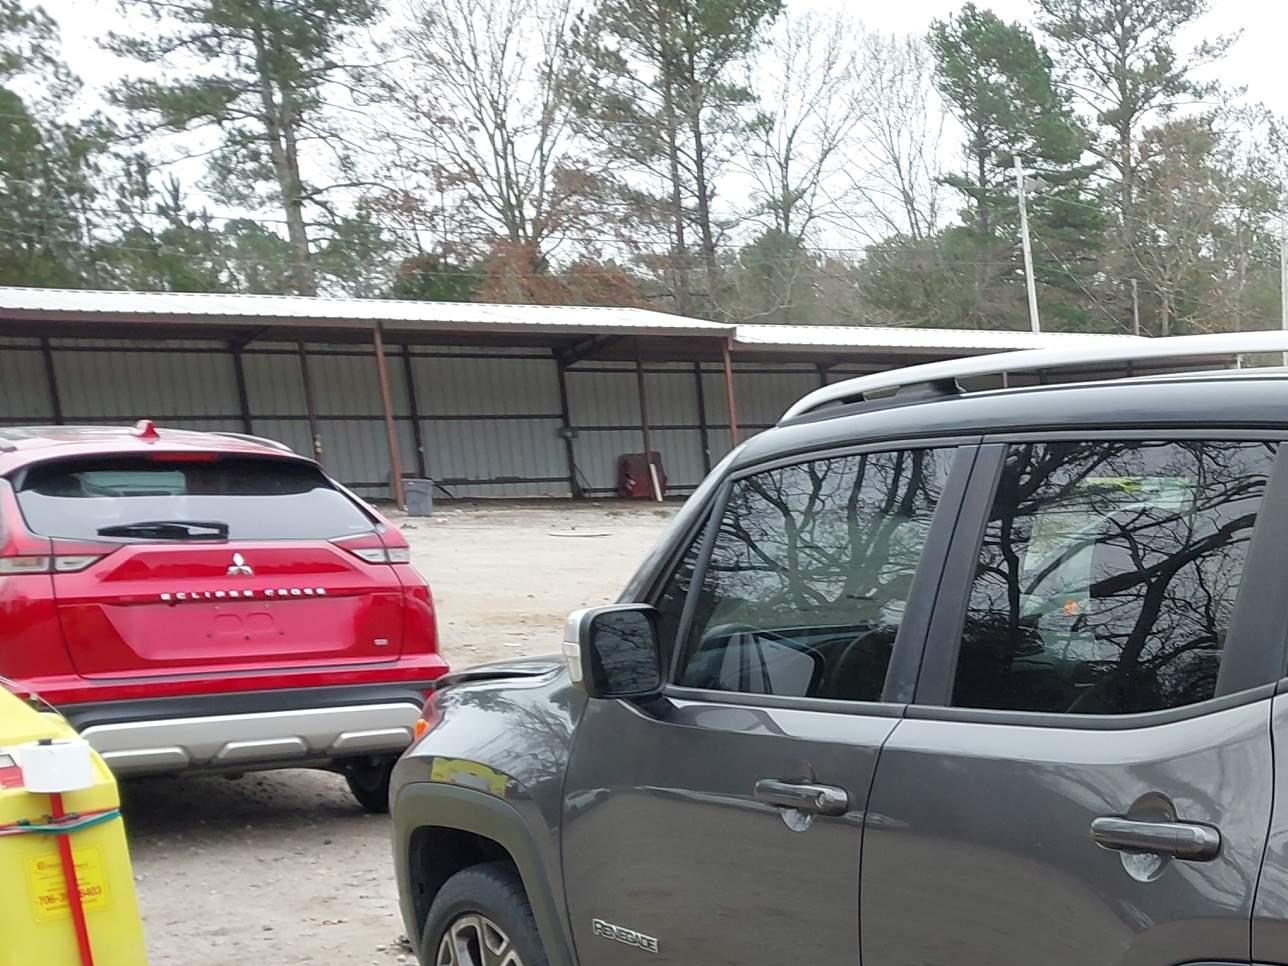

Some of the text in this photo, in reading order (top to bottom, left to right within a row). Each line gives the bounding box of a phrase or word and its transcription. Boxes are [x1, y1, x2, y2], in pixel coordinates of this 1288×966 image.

[160, 587, 327, 601] ECLIPSE CROSS
[592, 918, 659, 954] RENEGADE
